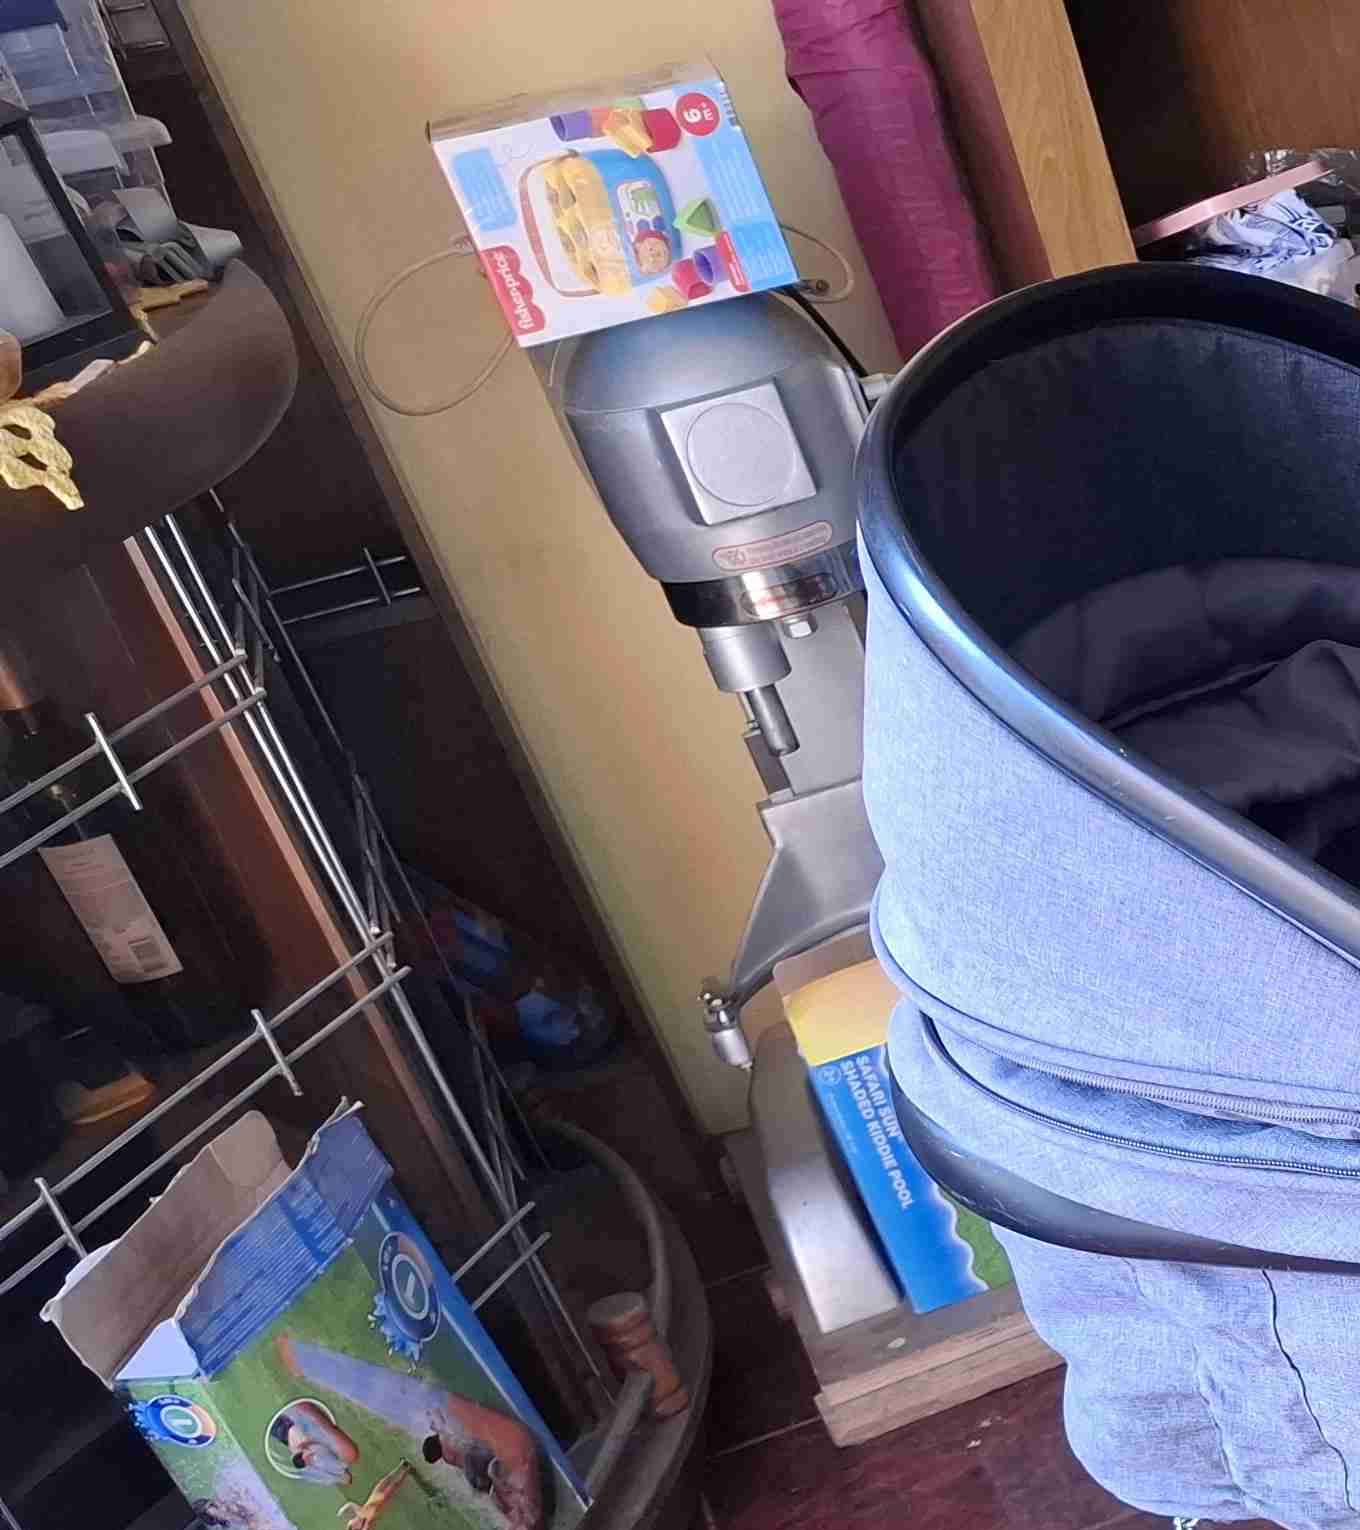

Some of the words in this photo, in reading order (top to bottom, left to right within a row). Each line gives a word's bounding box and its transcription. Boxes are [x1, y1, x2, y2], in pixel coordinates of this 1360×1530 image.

[683, 107, 702, 123] 6
[839, 1060, 876, 1127] SHADED
[868, 1121, 899, 1170] KIDDIE
[889, 1169, 915, 1209] POOL
[855, 1055, 887, 1105] SAFARI
[875, 1105, 901, 1139] SUN
